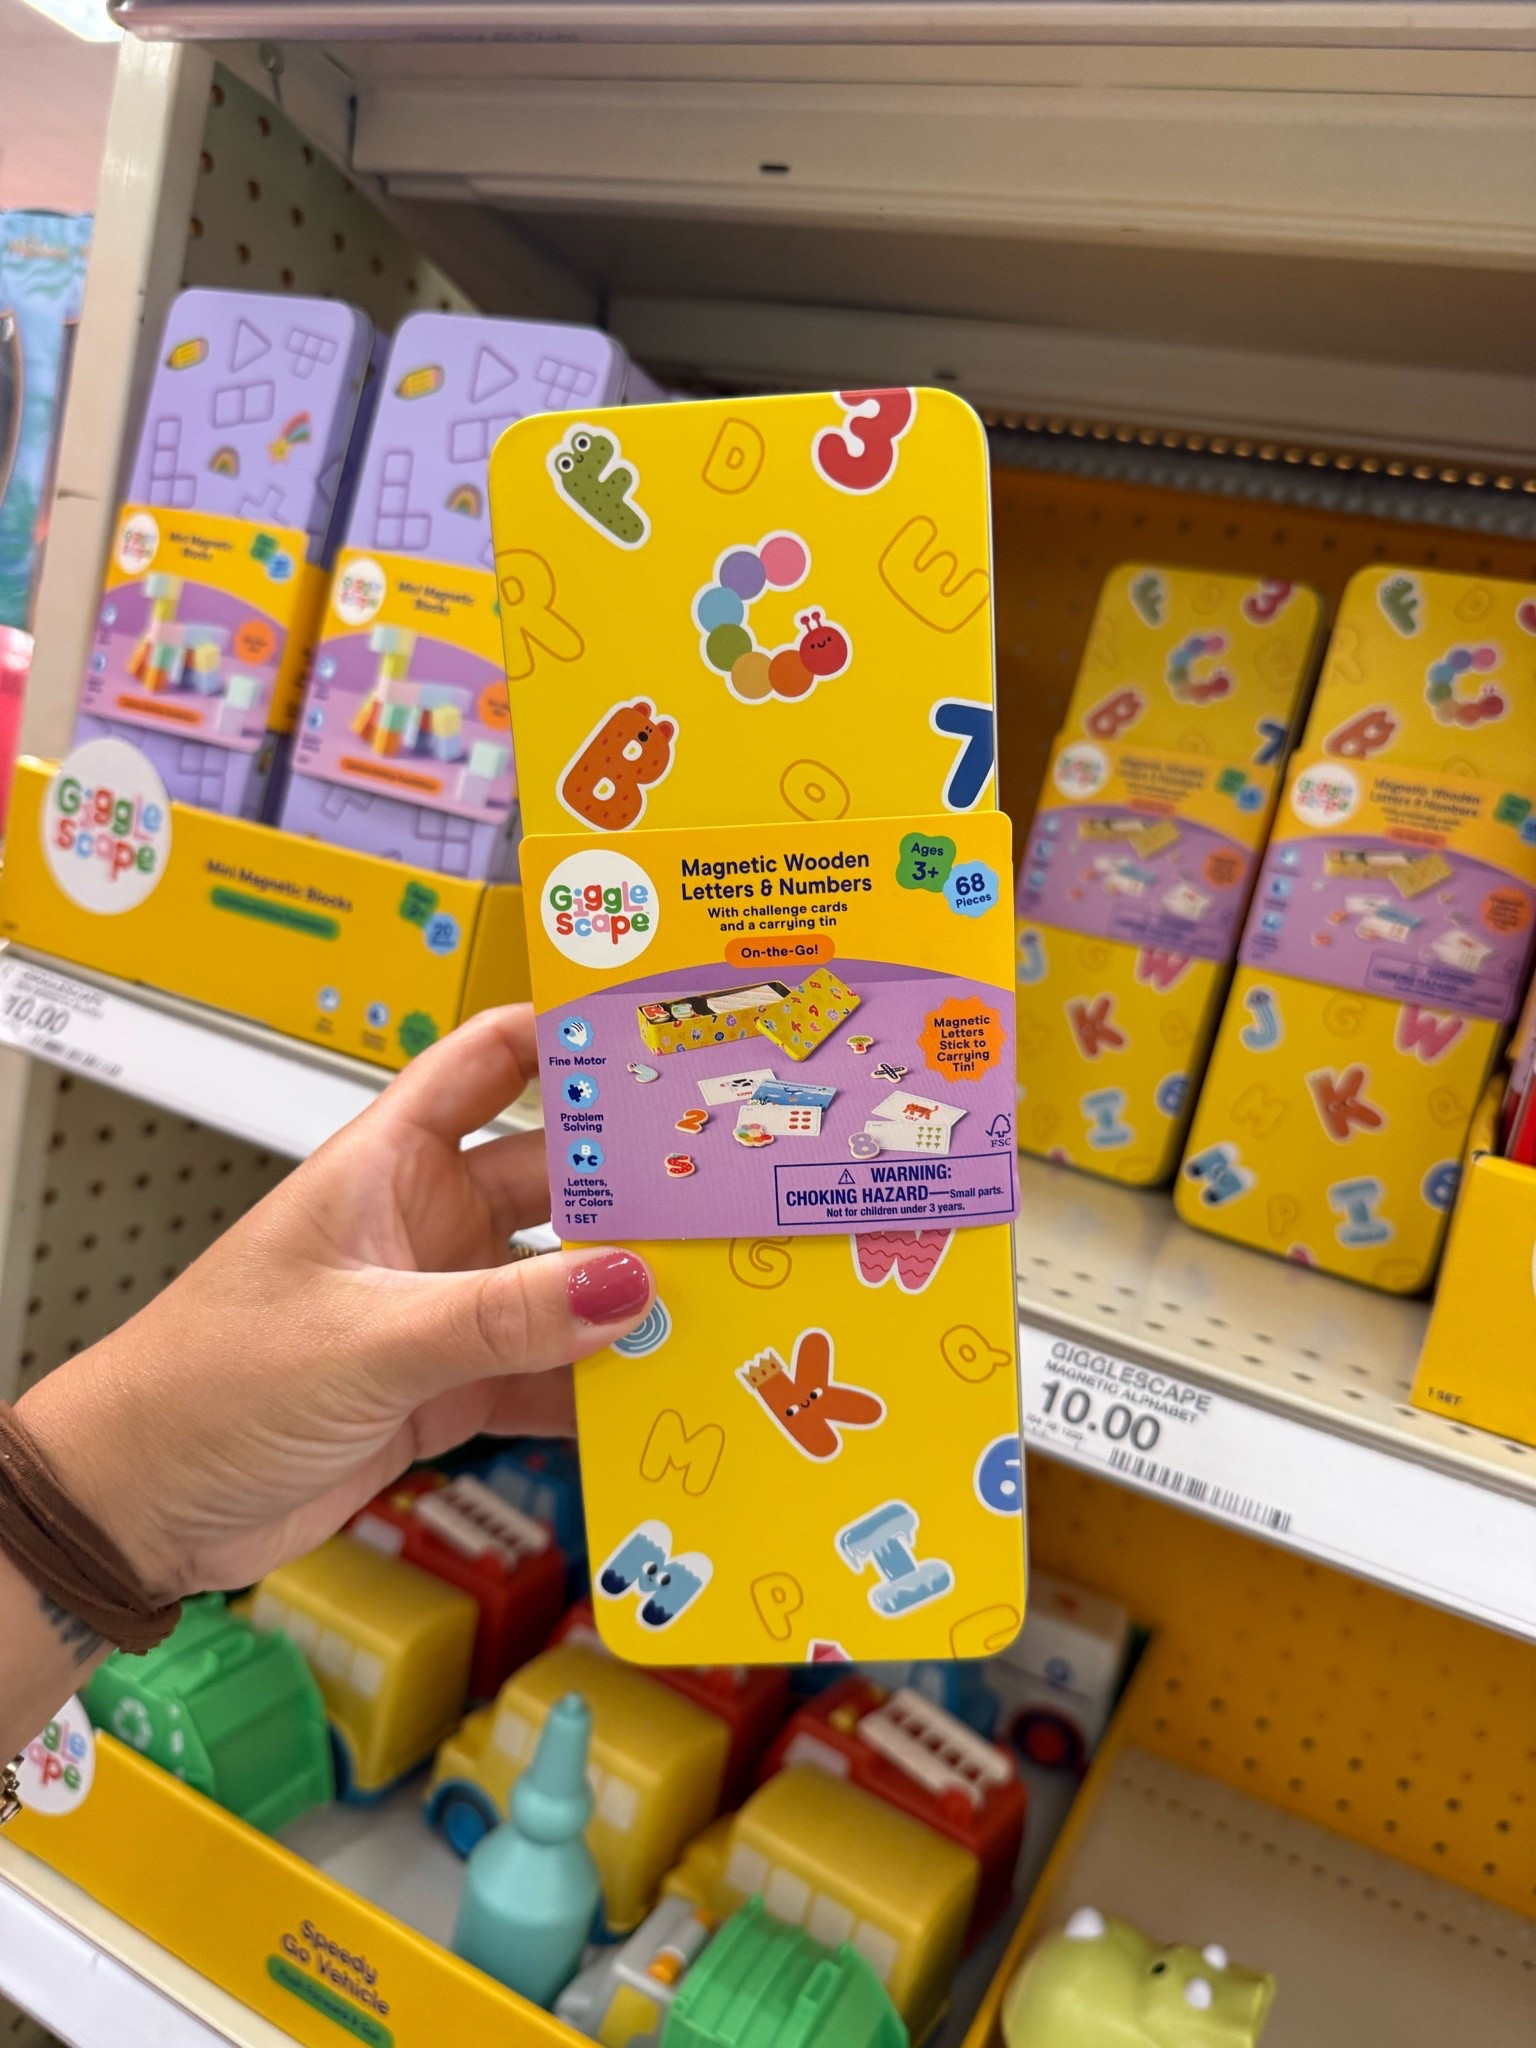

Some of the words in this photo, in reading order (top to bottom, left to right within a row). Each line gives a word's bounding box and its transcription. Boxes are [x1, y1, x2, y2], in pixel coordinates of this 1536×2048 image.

[911, 842, 944, 857] Ages
[681, 855, 777, 880] Magnetic
[784, 851, 870, 872] Wooden
[912, 861, 939, 881] 3+
[681, 881, 754, 900] Letters
[760, 879, 773, 897] &
[779, 876, 872, 896] Numbers
[956, 872, 985, 896] 68
[956, 893, 992, 909] Pieces
[707, 906, 739, 919] With
[743, 903, 807, 917] challenge
[811, 901, 848, 913] cards
[720, 920, 744, 932] and
[748, 922, 756, 930] a
[759, 917, 815, 931] carrying
[819, 915, 837, 927] tin
[741, 944, 819, 959] On-the-Go!
[934, 1015, 991, 1029] Magnetic
[941, 1028, 984, 1039] Letters
[939, 1039, 970, 1051] Stick
[973, 1039, 986, 1048] to
[549, 1056, 571, 1066] Fine
[574, 1055, 607, 1066] Motor
[936, 1050, 990, 1063] Carrying
[952, 1061, 975, 1073] Tin!
[560, 1113, 604, 1123] Problem
[563, 1122, 603, 1134] Solving
[990, 1138, 1012, 1148] FSC
[870, 1164, 952, 1183] WARNING:
[567, 1177, 608, 1188] Letters,
[563, 1187, 614, 1198] Numbers,
[786, 1188, 857, 1207] CHOKING
[978, 1185, 1004, 1198] parts.
[565, 1199, 574, 1207] or
[578, 1197, 614, 1207] Colors
[826, 1207, 843, 1218] Not
[847, 1207, 859, 1217] for
[860, 1205, 898, 1217] children
[900, 1204, 927, 1214] under
[929, 1203, 936, 1212] 3
[937, 1202, 966, 1213] years.
[565, 1214, 571, 1223] 1
[575, 1213, 598, 1224] SET
[1051, 1341, 1213, 1413] GIGGLESCAPE
[1044, 1359, 1120, 1394] MAGNETIC
[1120, 1388, 1199, 1423] ALPHABET
[1041, 1379, 1161, 1451] 10.00
[302, 1919, 378, 1985] Speedy
[282, 1933, 310, 1963] Go
[317, 1953, 390, 2015] Vehicle
